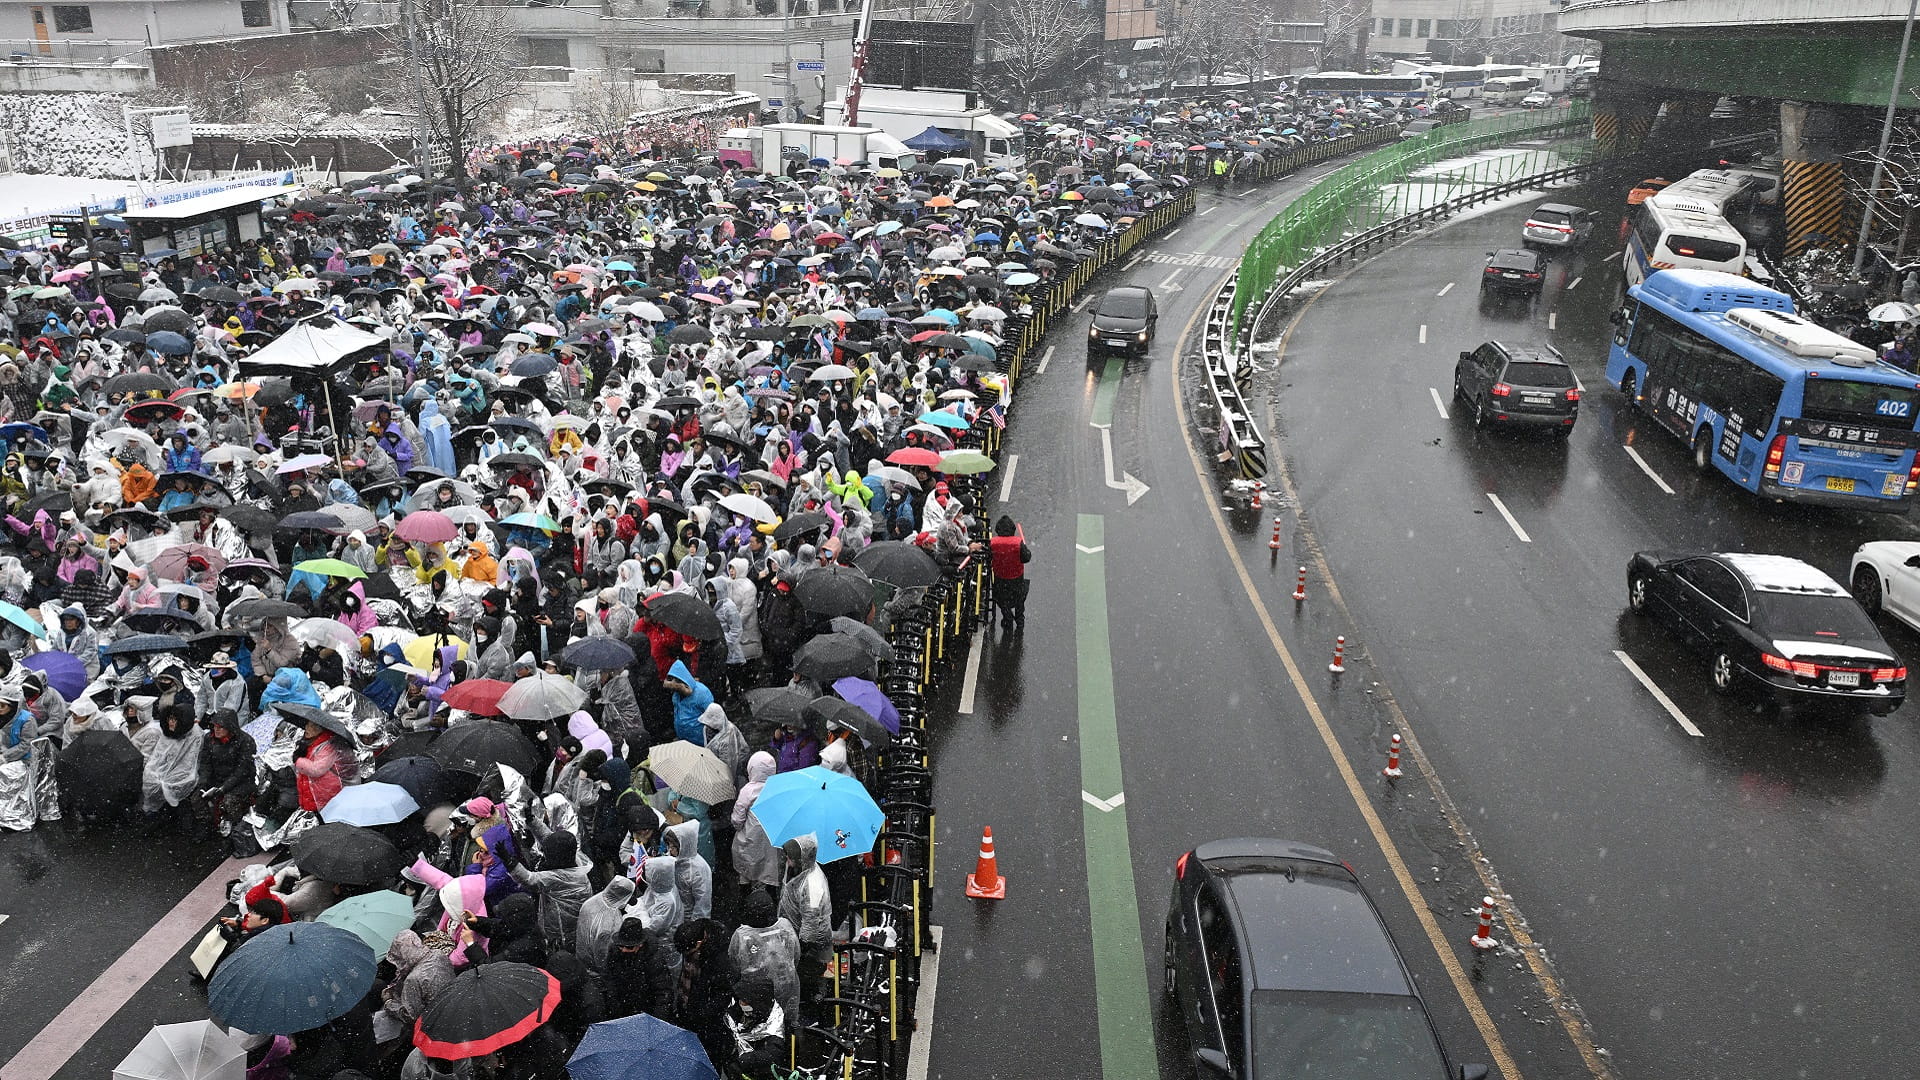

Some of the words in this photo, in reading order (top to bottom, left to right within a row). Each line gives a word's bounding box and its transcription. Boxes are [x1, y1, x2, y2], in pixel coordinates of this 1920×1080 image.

[1666, 387, 1699, 425] 하얼빈
[1879, 400, 1908, 417] 402
[1703, 407, 1718, 426] 402
[1827, 427, 1879, 443] 하얼빈
